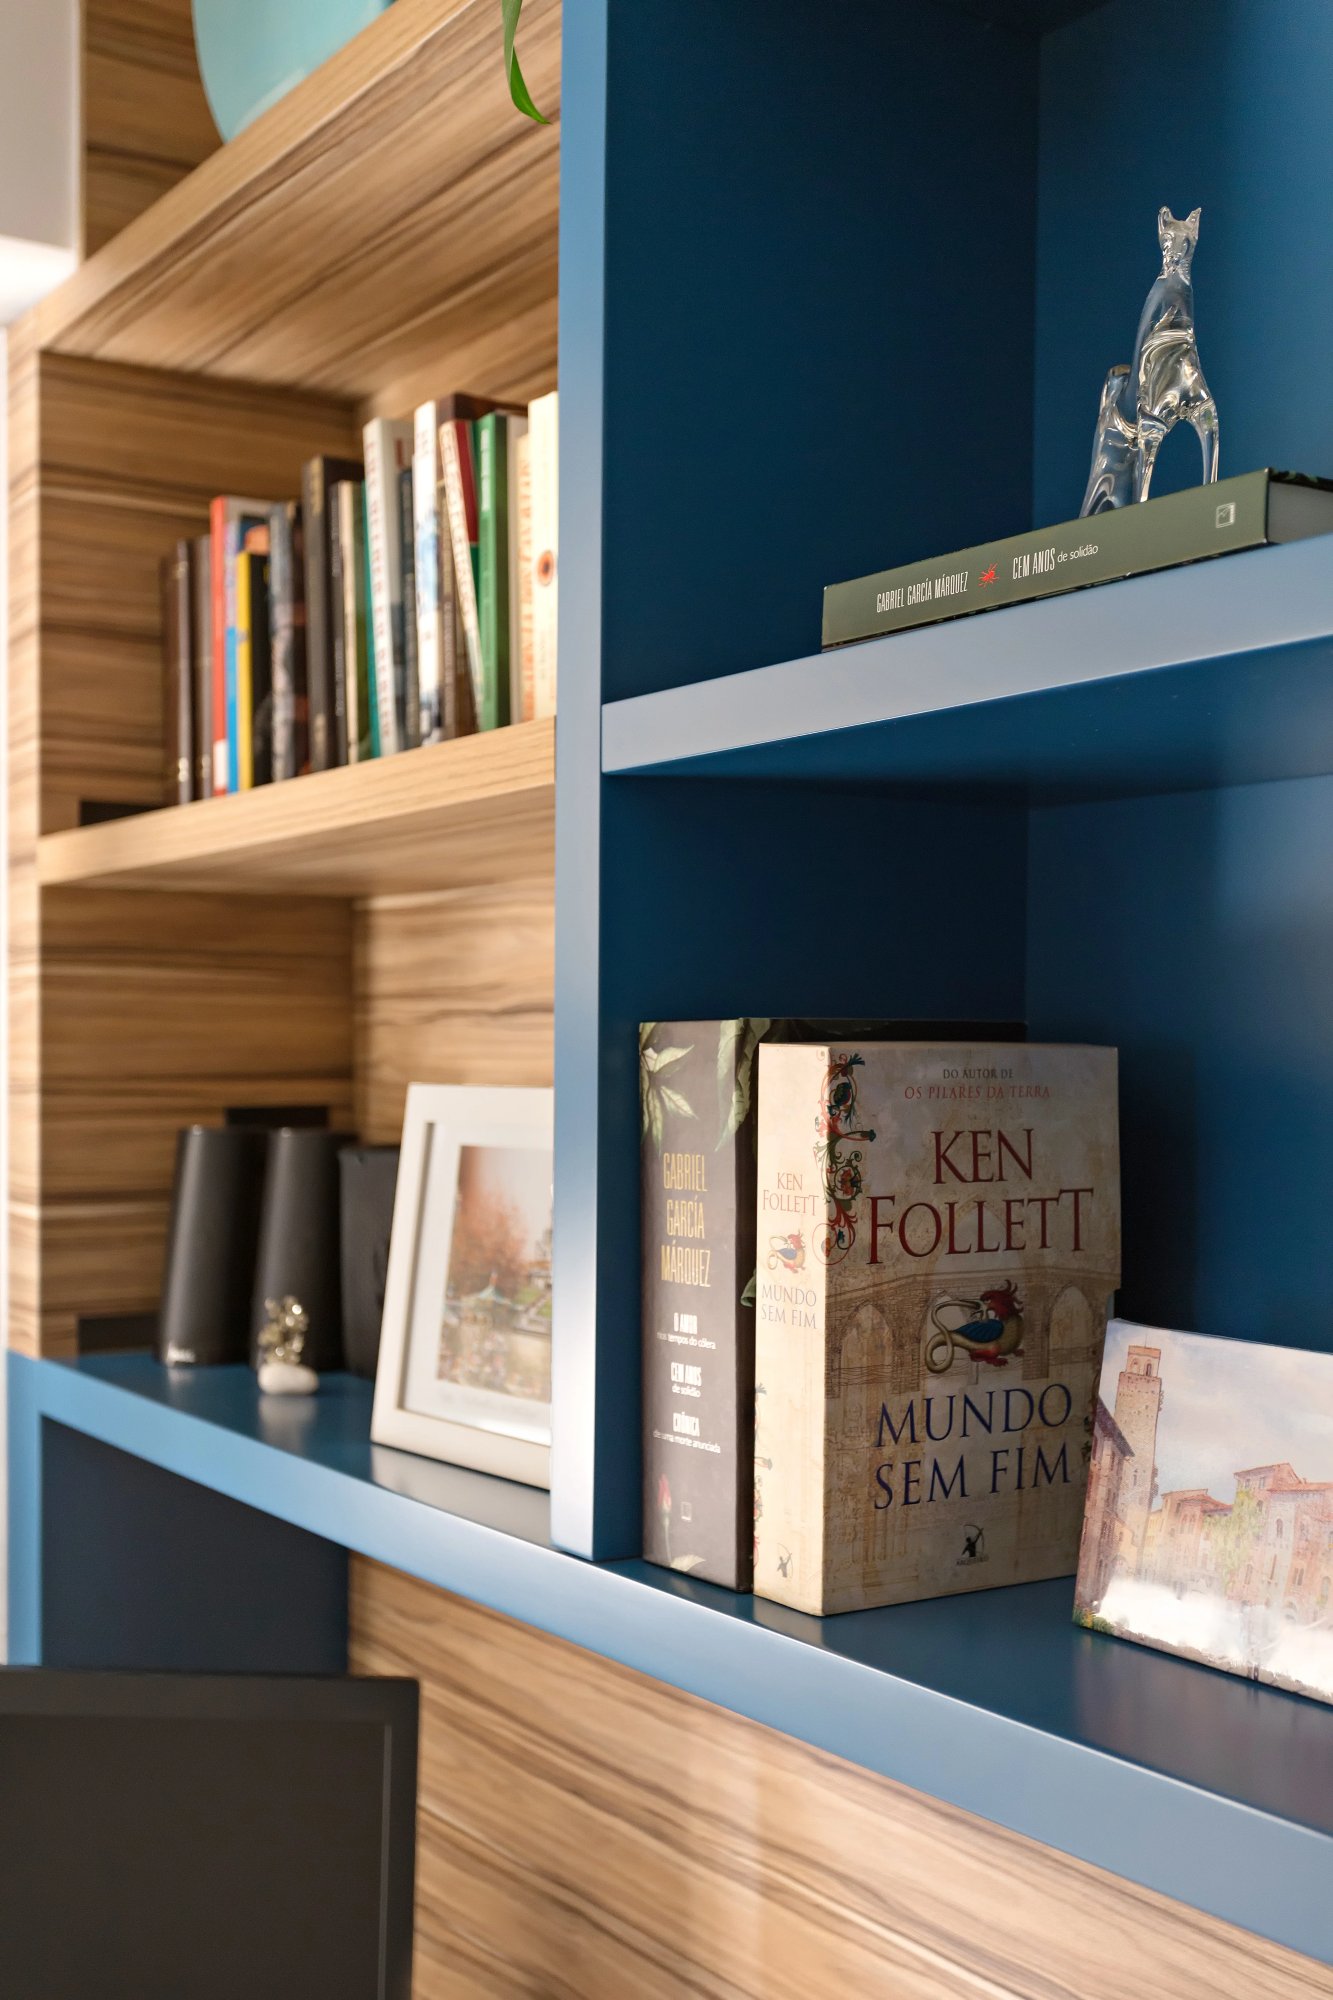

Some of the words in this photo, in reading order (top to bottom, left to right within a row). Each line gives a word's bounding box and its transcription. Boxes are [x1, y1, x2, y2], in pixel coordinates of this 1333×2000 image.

[1012, 554, 1030, 580] CEM
[1032, 548, 1056, 574] ANOS
[1057, 552, 1068, 563] de
[1070, 544, 1098, 560] solidão
[877, 588, 905, 613] GABRIEL
[907, 578, 932, 606] GARCÍA
[935, 571, 968, 599] MÁRQUEZ
[943, 1069, 958, 1079] DO
[962, 1068, 998, 1079] AUTOR
[1001, 1068, 1013, 1079] DE
[904, 1086, 922, 1100] OS
[928, 1086, 981, 1100] PILARES
[987, 1086, 1004, 1099] DA
[1009, 1086, 1050, 1098] TERRA
[663, 1153, 708, 1191] GABRIEL
[931, 1128, 1034, 1185] KEN
[777, 1172, 803, 1190] KEN
[667, 1195, 705, 1239] GARCÍA
[763, 1190, 819, 1216] FOLLETT
[866, 1187, 1094, 1265] FOLLETT
[661, 1240, 711, 1287] MÁRQUEZ
[762, 1284, 817, 1307] MUNDO
[761, 1304, 786, 1324] SEM
[791, 1309, 817, 1329] FIM
[874, 1383, 1071, 1448] MUNDO
[874, 1454, 970, 1510] SEM
[990, 1442, 1071, 1494] FIM
